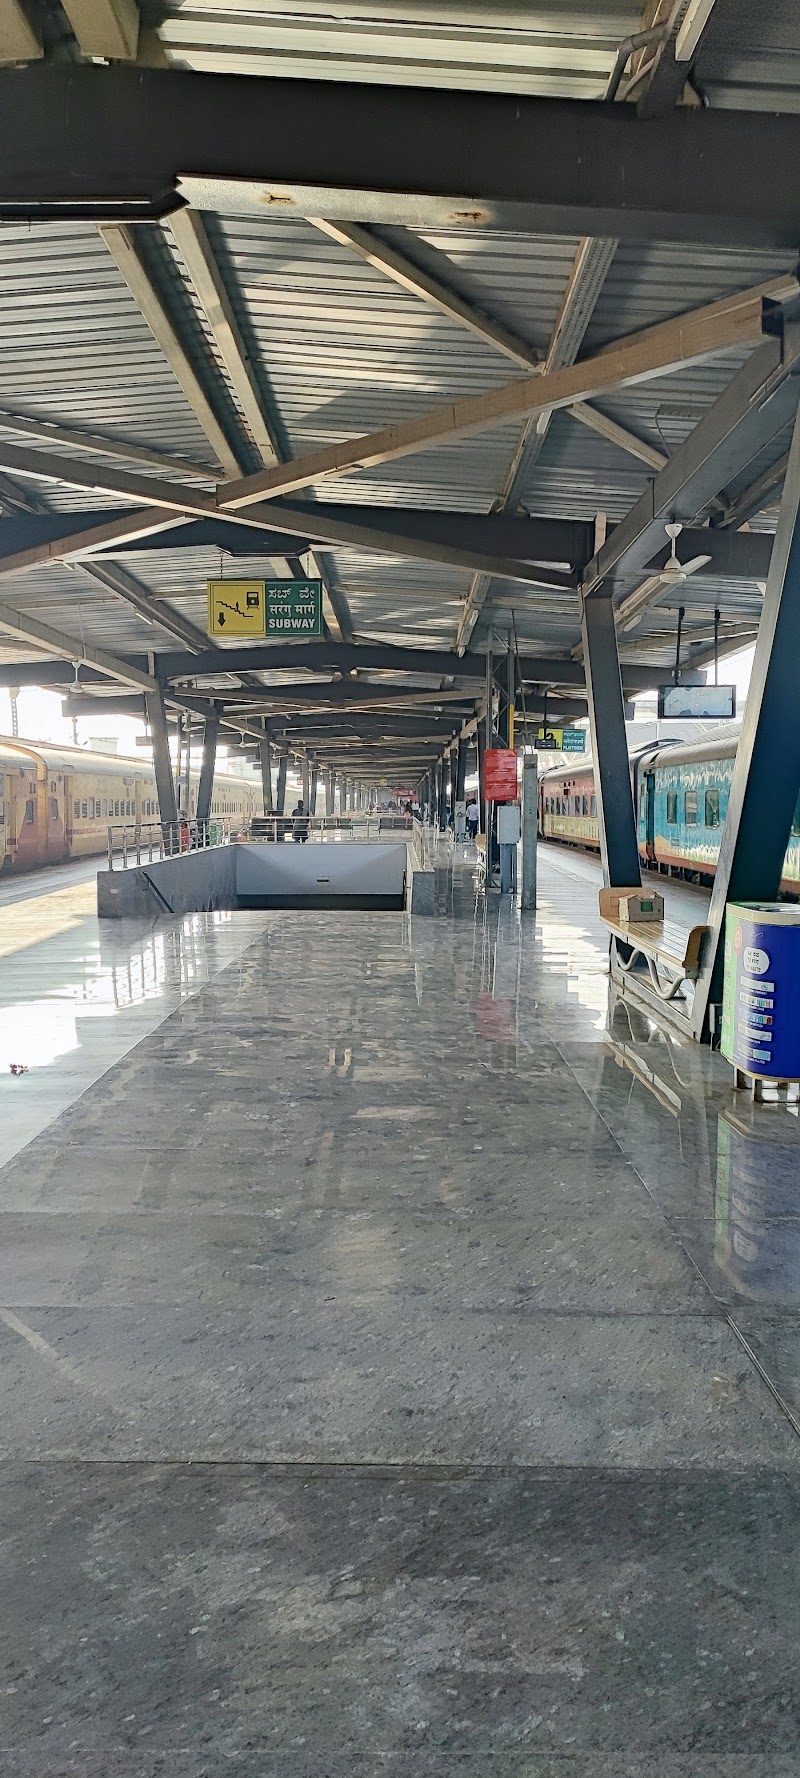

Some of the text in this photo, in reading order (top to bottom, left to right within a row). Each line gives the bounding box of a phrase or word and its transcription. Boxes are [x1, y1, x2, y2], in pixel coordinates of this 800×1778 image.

[268, 587, 315, 598] ಸಬ್ ವೇ
[294, 601, 315, 614] मार्ग
[268, 618, 315, 628] SUBWAY
